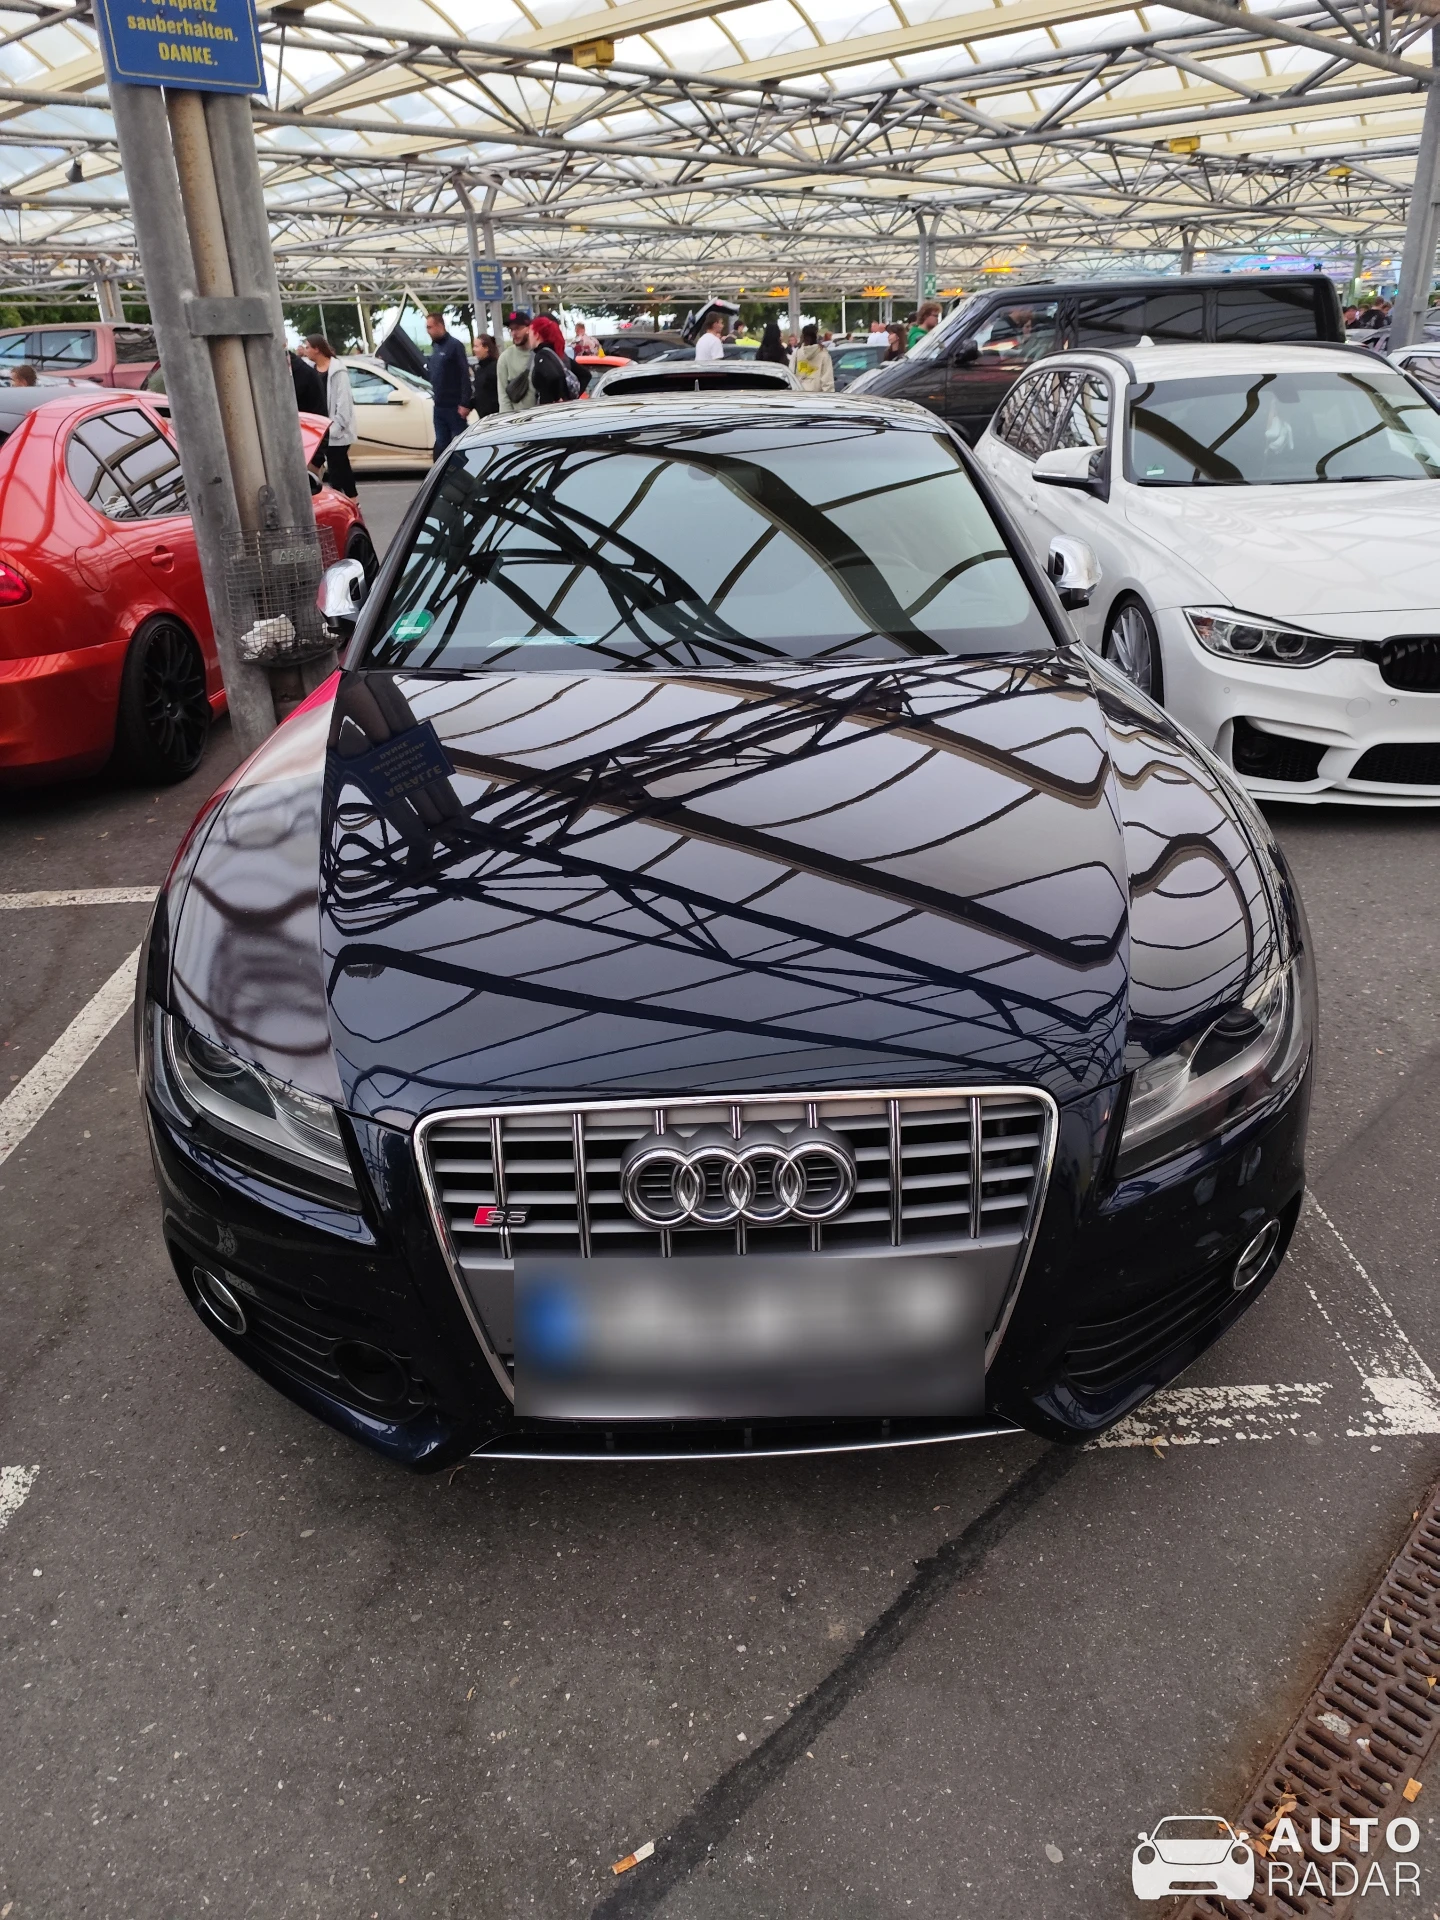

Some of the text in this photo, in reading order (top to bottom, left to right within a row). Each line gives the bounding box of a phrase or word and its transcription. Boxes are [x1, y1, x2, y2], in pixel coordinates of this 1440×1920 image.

[142, 0, 217, 12] platz
[127, 14, 239, 42] sauberhalten.
[158, 42, 219, 66] DANKE.
[485, 1210, 527, 1224] S5
